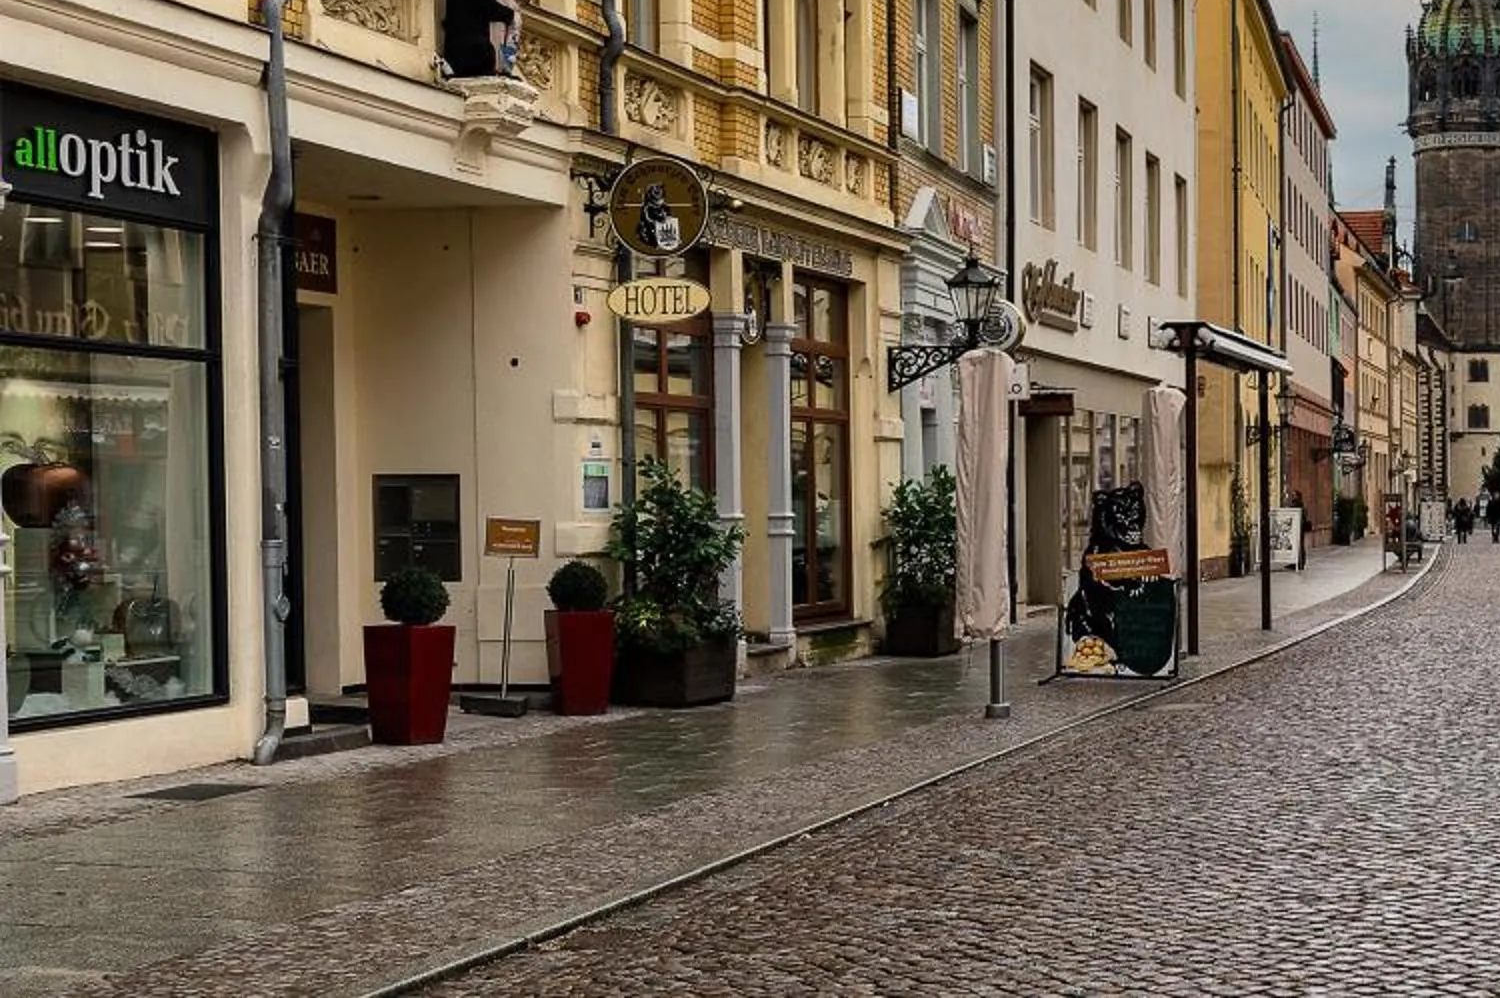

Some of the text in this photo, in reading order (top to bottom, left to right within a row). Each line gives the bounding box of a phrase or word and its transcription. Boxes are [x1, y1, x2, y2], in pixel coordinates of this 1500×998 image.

[14, 126, 181, 199] alloptik
[295, 251, 329, 275] AER
[624, 285, 696, 316] HOTEL
